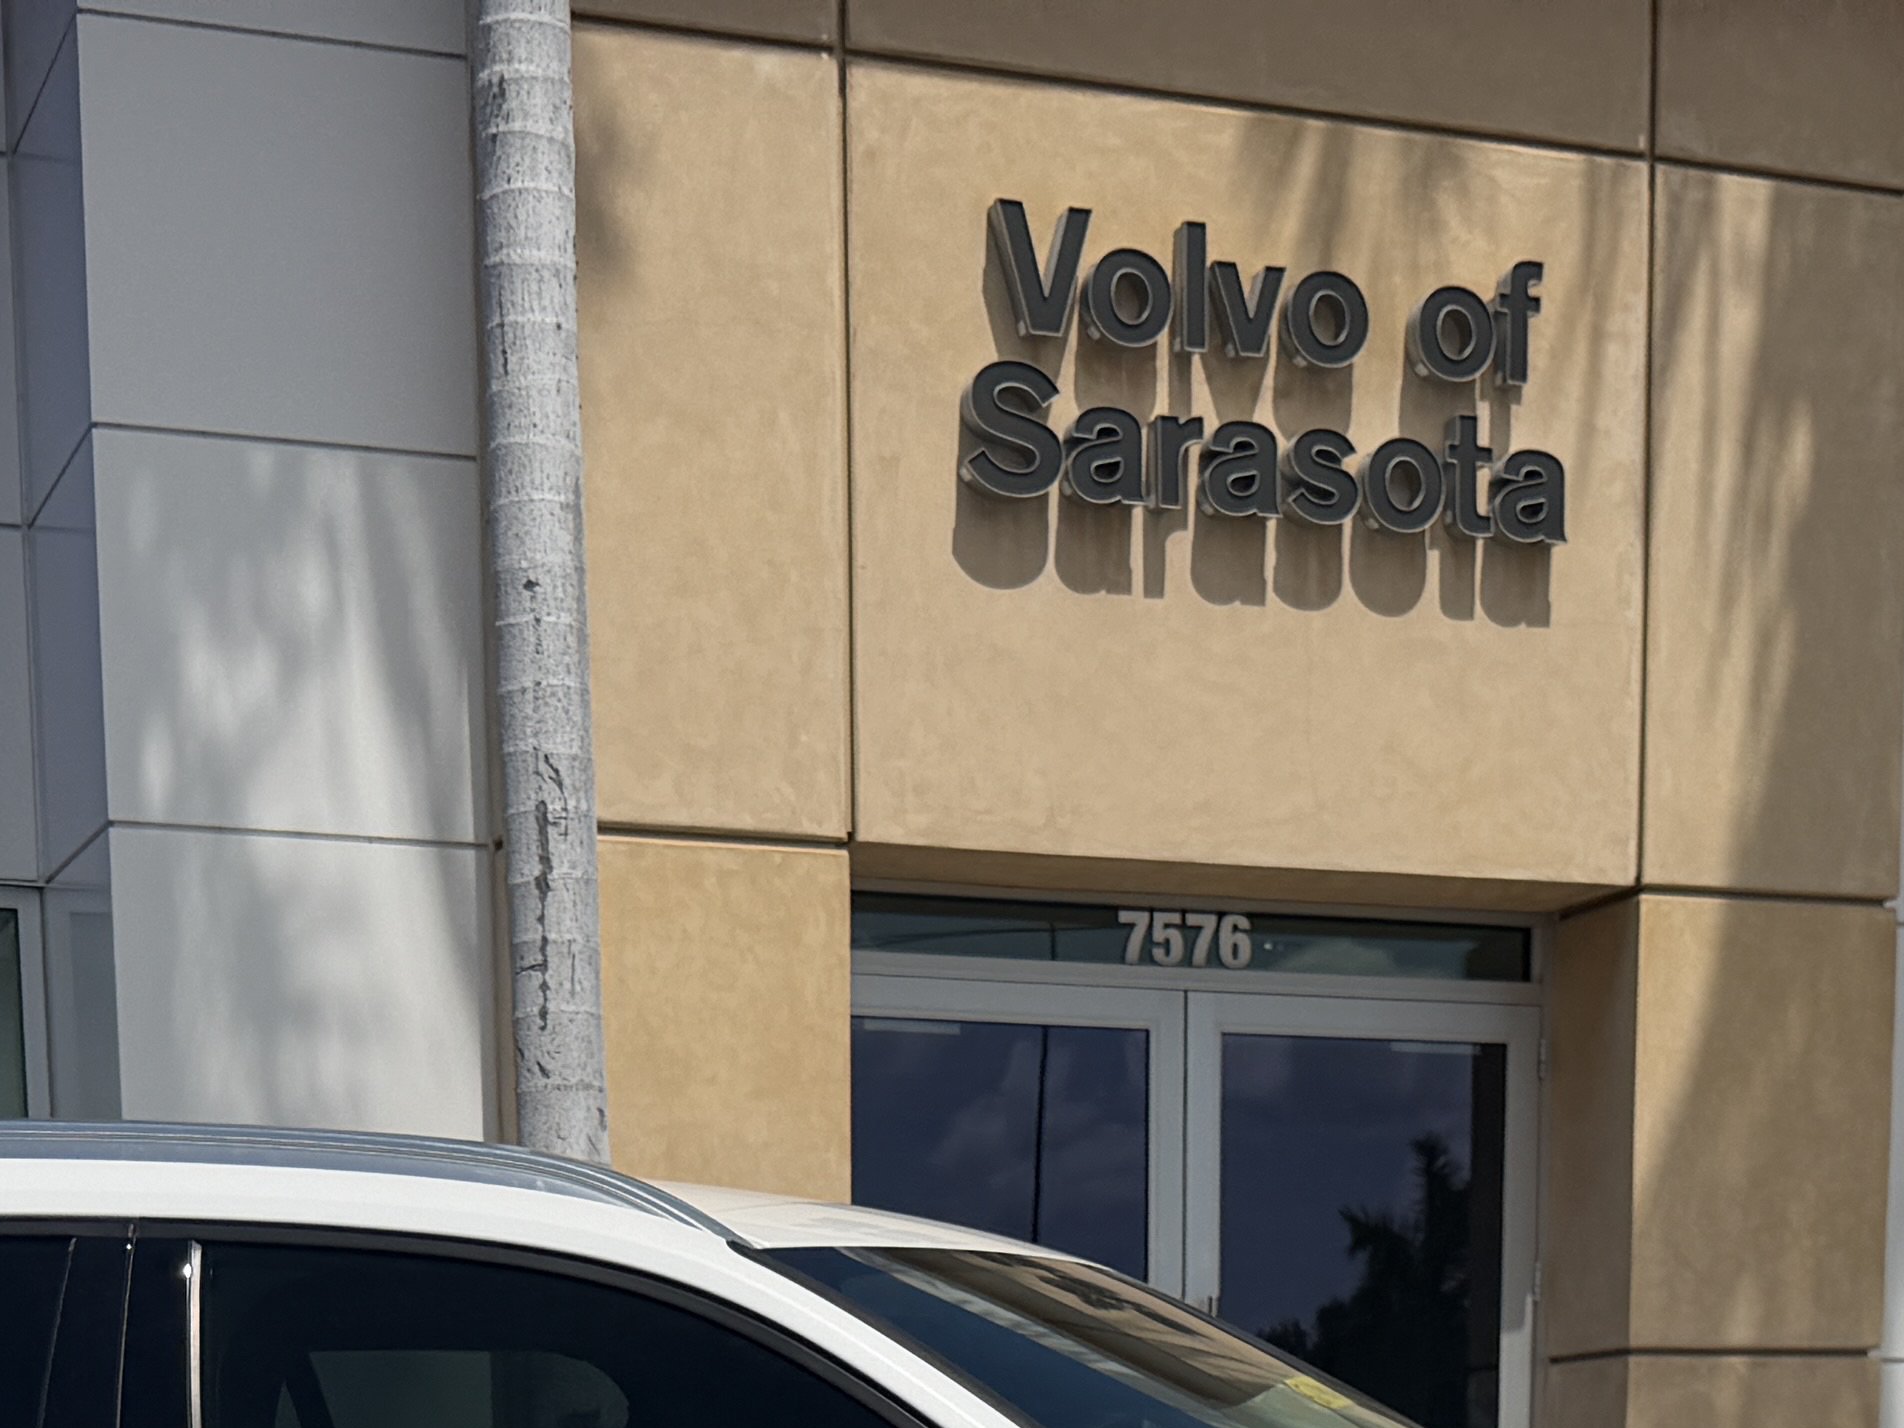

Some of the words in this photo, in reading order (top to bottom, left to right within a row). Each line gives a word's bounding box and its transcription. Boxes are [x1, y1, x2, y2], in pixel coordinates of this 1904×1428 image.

[986, 198, 1369, 368] Volvo
[1406, 260, 1544, 384] of
[959, 360, 1568, 543] Sarasota
[1117, 910, 1252, 969] 7576
